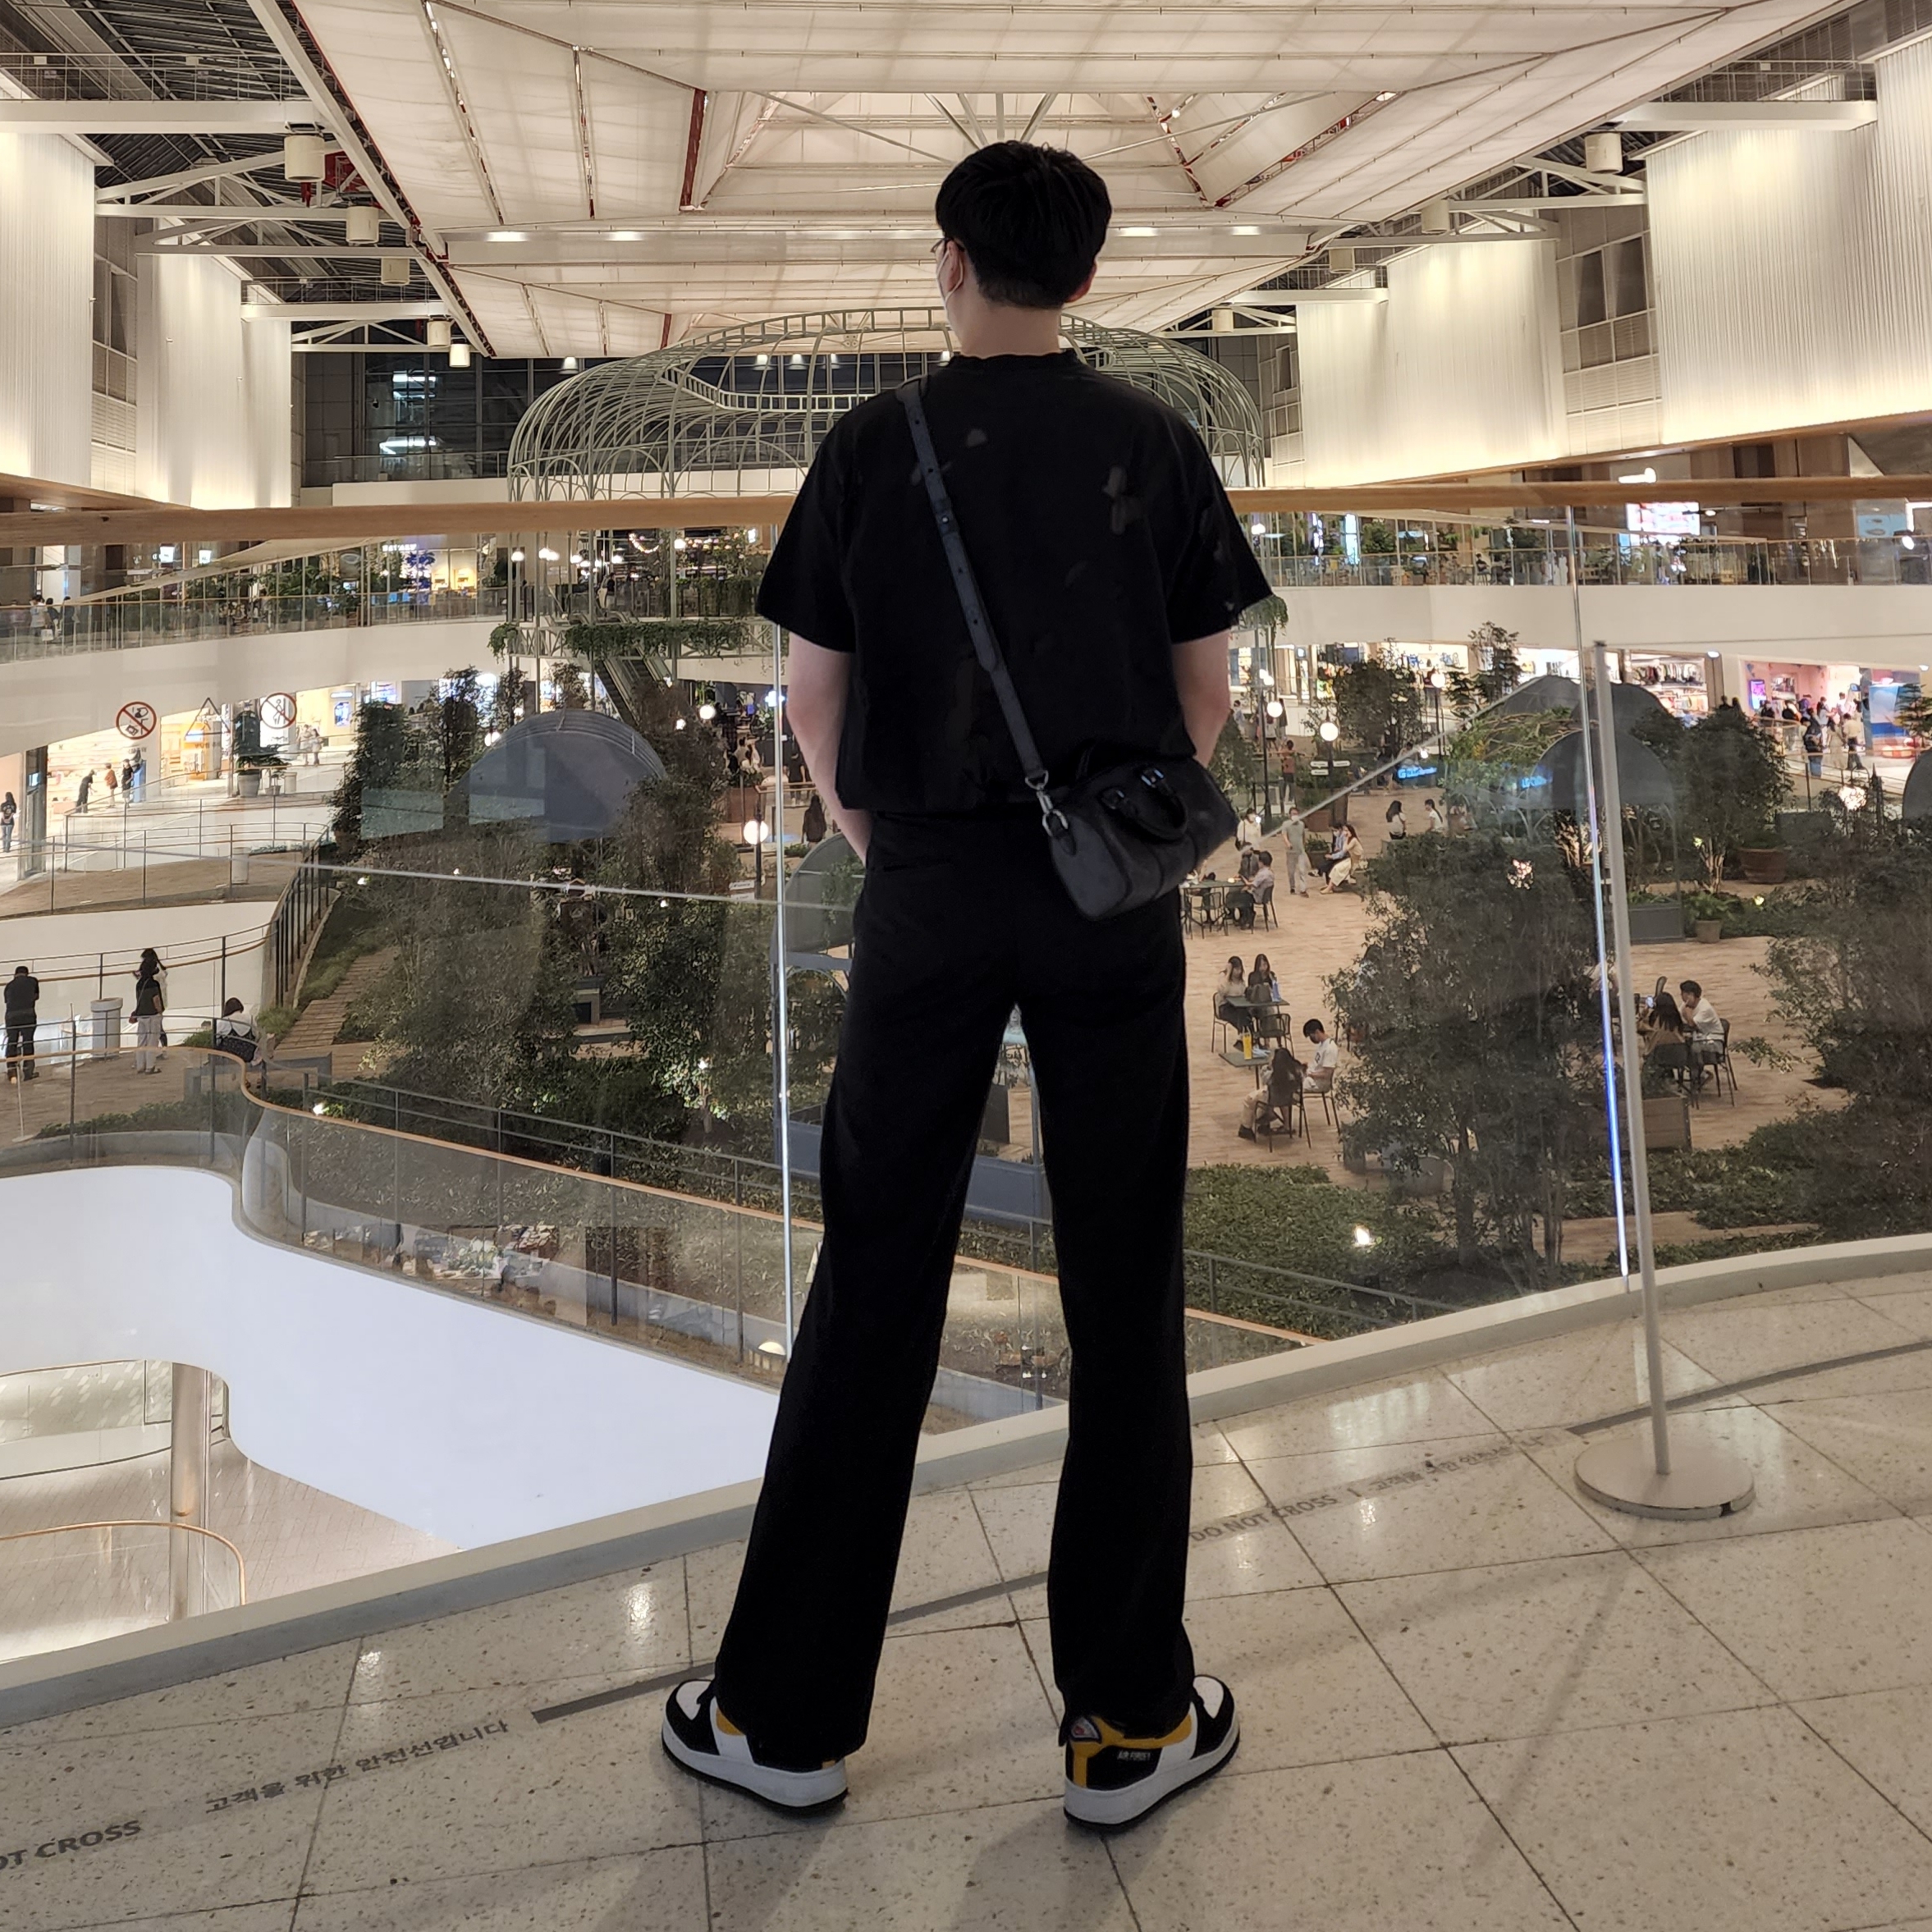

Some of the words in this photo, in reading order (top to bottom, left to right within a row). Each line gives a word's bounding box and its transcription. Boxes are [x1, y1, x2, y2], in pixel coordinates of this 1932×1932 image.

[1190, 1526, 1223, 1542] DO
[1223, 1513, 1270, 1532] NOT
[1271, 1494, 1339, 1519] CROSS
[205, 1781, 286, 1814] 고객을
[295, 1765, 350, 1788] 위한
[355, 1719, 510, 1772] 안전선입니다
[34, 1819, 142, 1859] CROSS
